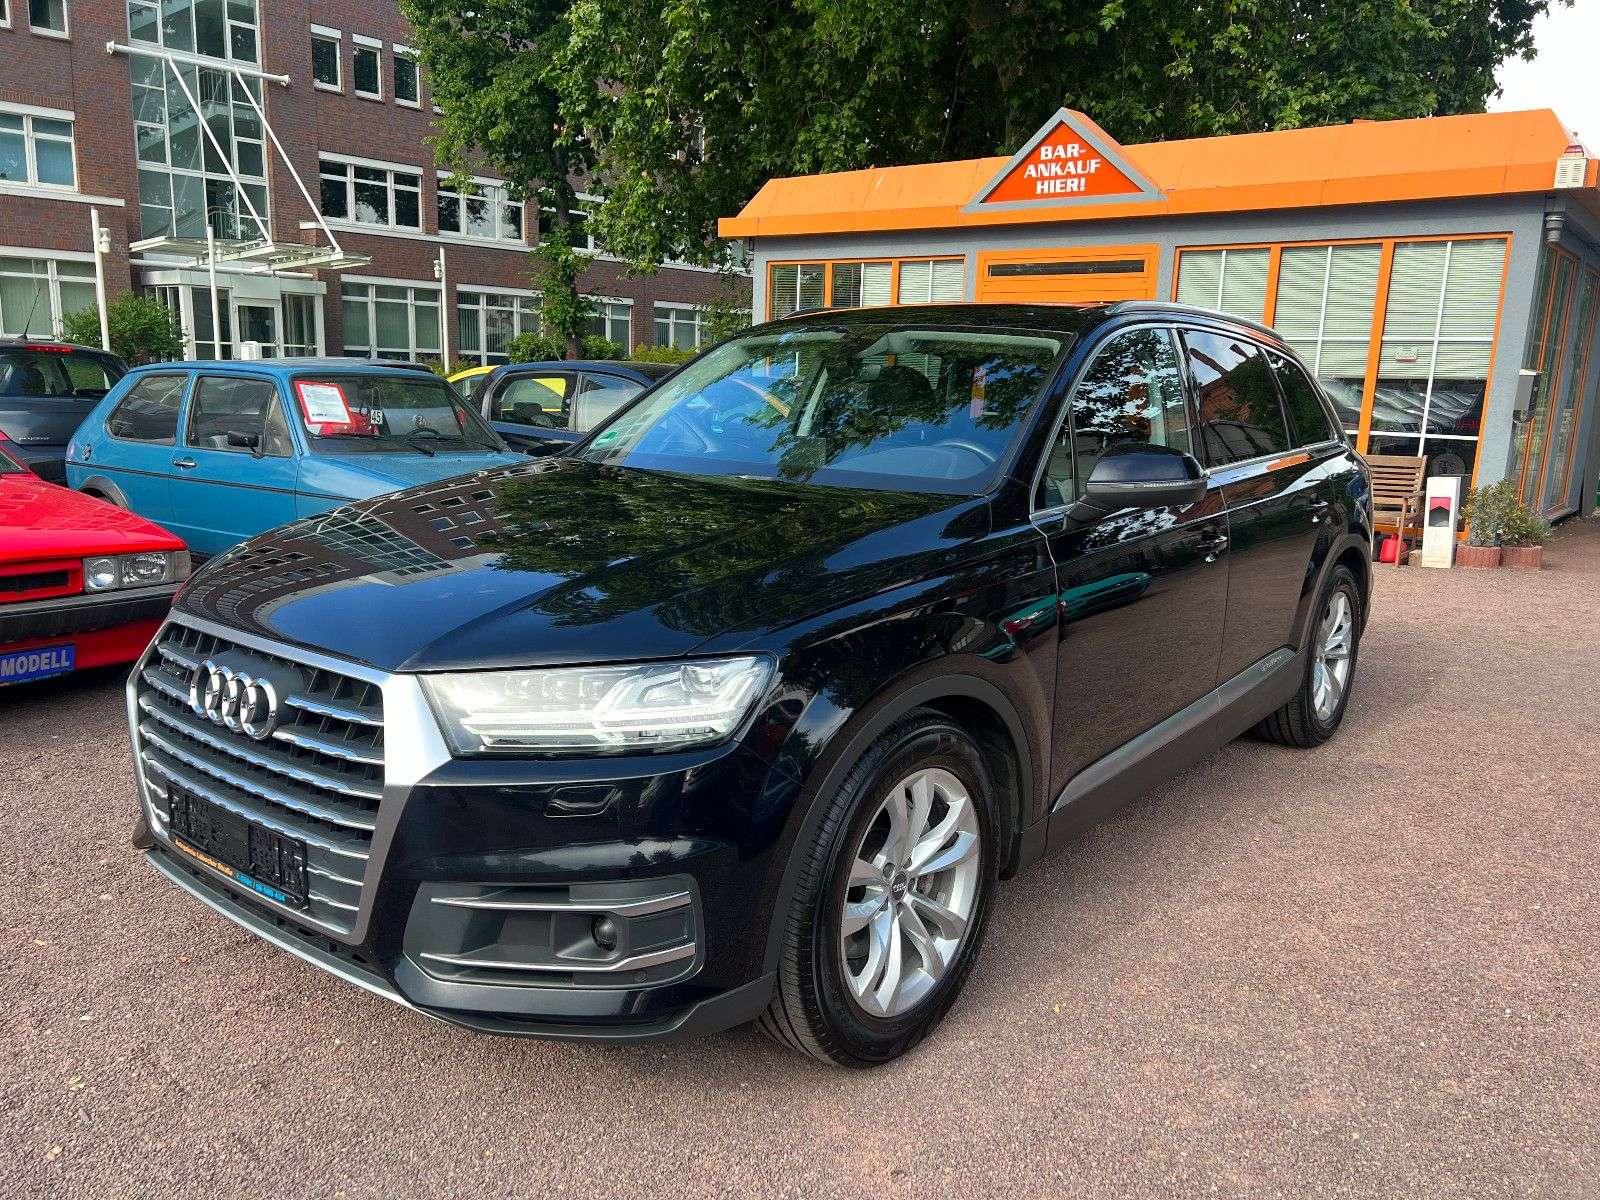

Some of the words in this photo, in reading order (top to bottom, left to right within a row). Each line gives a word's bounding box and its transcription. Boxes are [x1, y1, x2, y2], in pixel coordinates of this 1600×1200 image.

[1040, 143, 1087, 160] BAR-
[1024, 159, 1101, 178] ANKAUF
[1036, 177, 1086, 194] HIER!
[0, 649, 70, 676] MODELL
